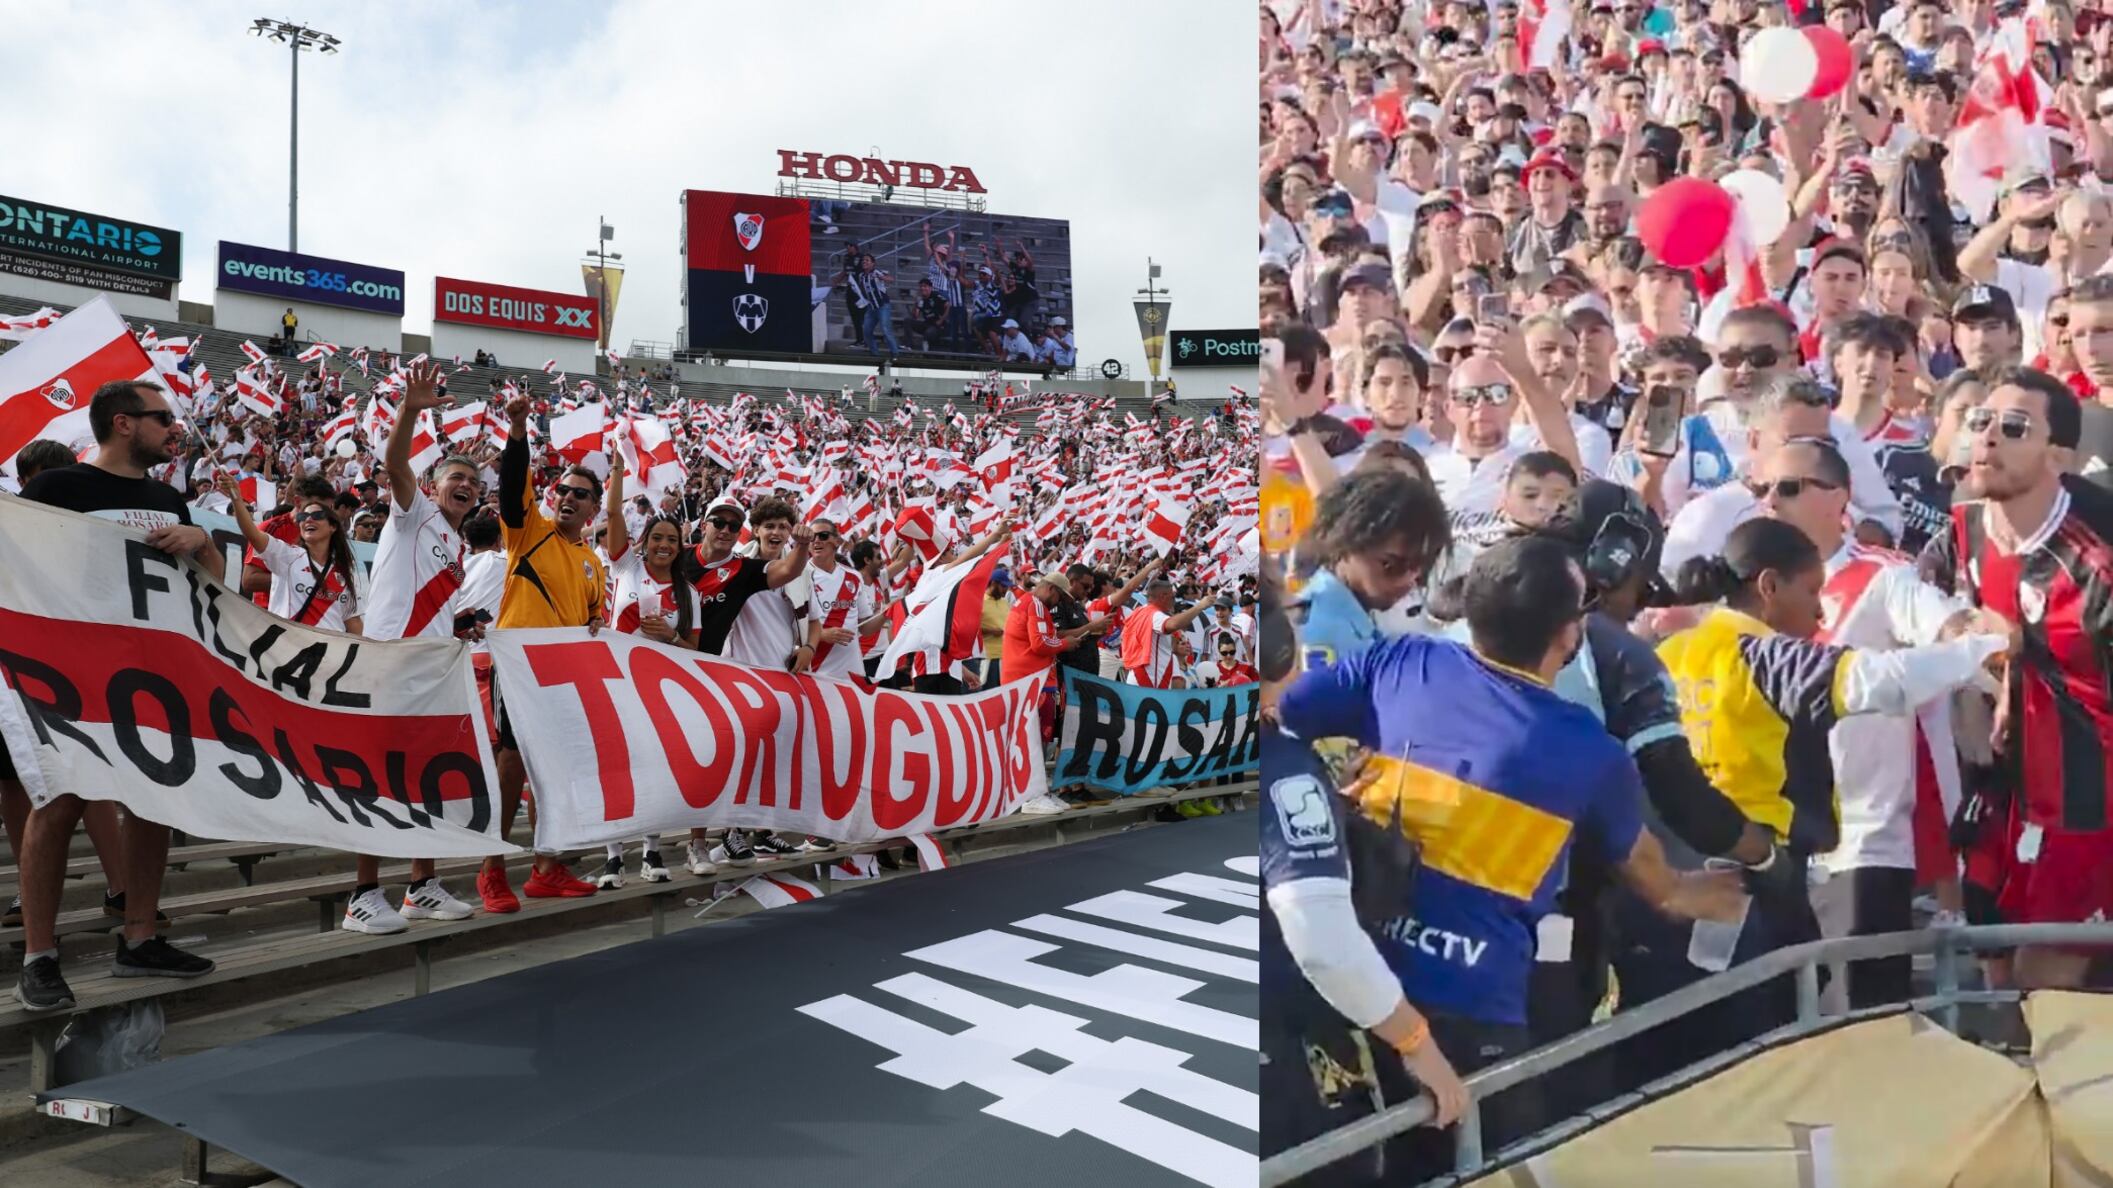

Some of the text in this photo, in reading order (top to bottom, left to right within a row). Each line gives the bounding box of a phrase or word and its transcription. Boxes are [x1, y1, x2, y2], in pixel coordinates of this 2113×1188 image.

[777, 149, 987, 194] HONDA
[12, 265, 39, 276] (626)
[65, 274, 85, 284] 5119
[87, 278, 111, 288] WITH
[15, 257, 66, 272] INCIDENTS
[69, 266, 82, 274] OF
[84, 269, 103, 278] FAN
[105, 273, 164, 289] MISCONDUCT
[103, 254, 160, 270] AIRPORT
[744, 264, 755, 284] V
[224, 259, 400, 301] events365.com
[445, 291, 592, 329] DOS EQUIS XX
[1103, 362, 1119, 375] 42
[125, 539, 371, 709] FILIAL
[0, 648, 491, 833] ROSARIO
[83, 1107, 90, 1120] J
